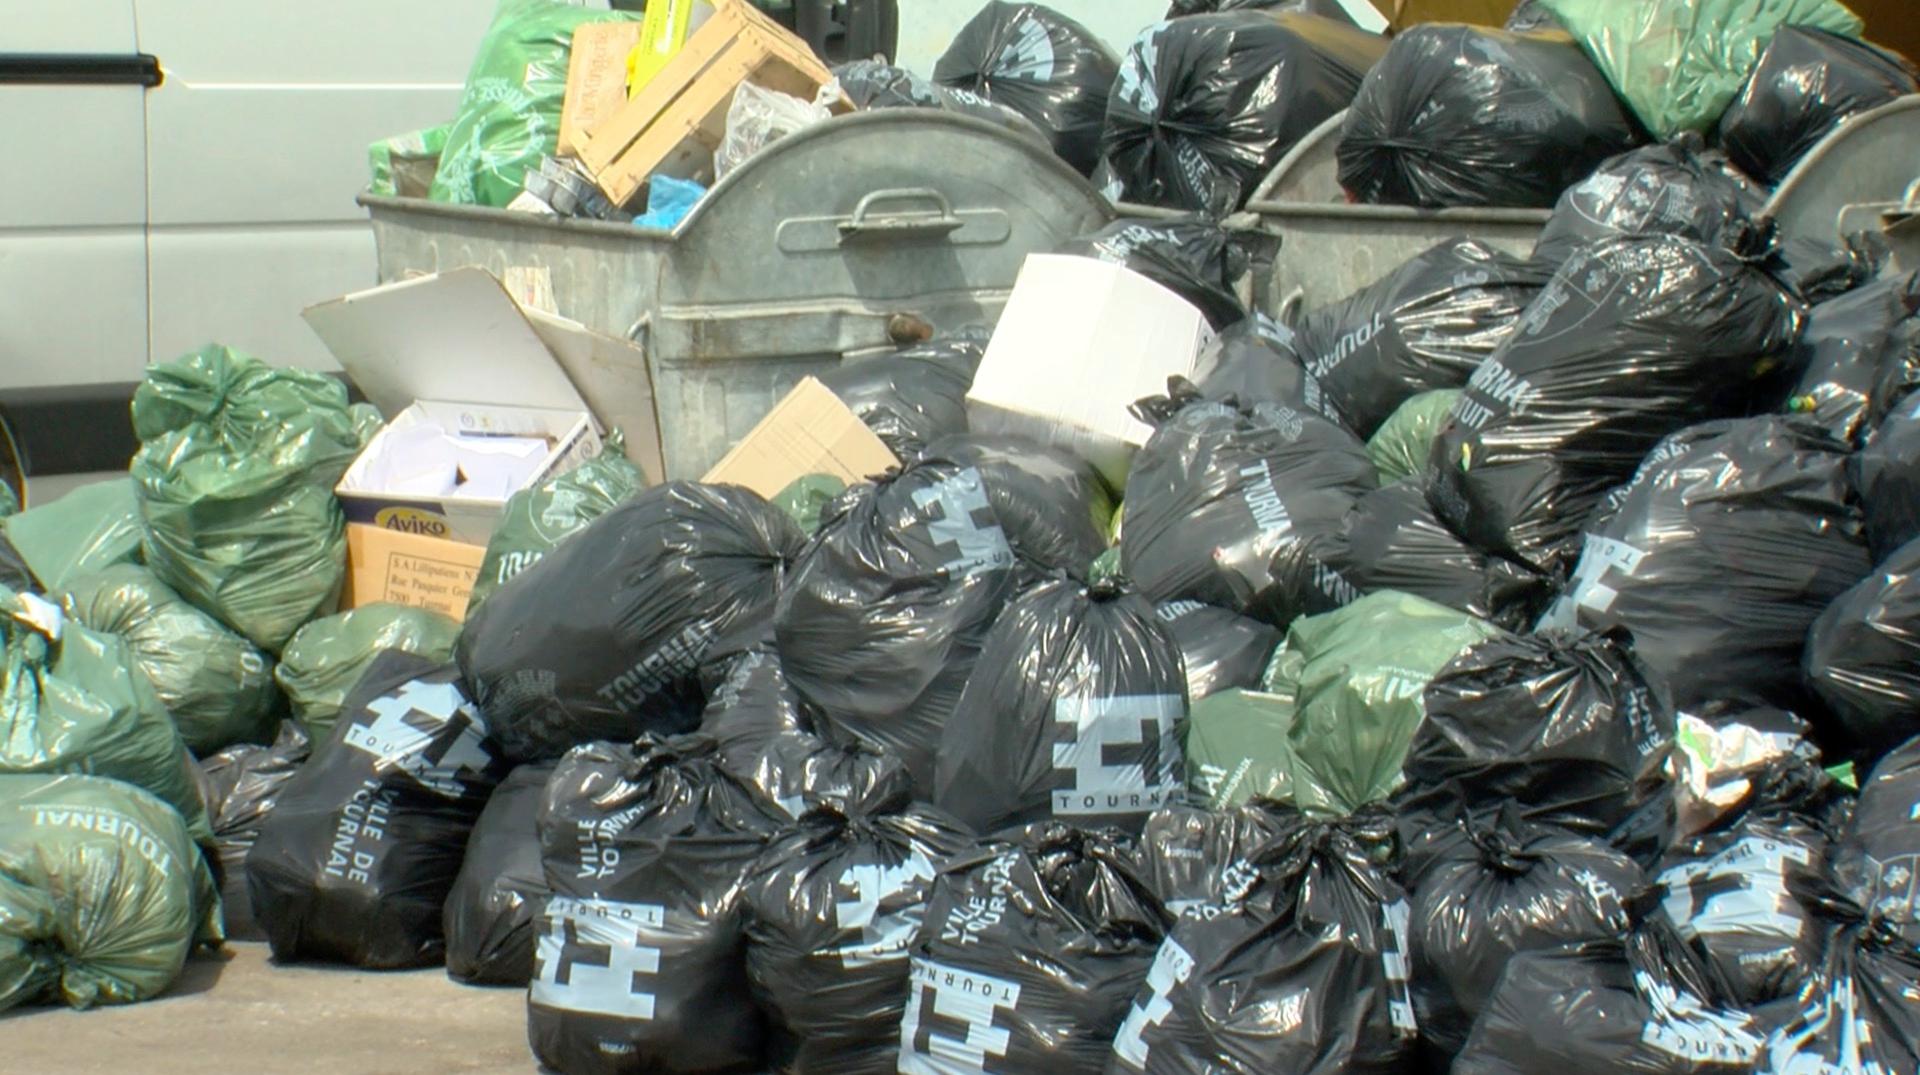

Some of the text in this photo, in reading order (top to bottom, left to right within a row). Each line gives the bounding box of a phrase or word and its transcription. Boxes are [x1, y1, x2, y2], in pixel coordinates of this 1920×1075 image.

[386, 513, 445, 539] Aviko
[390, 573, 408, 588] Rue
[34, 811, 170, 878] TOURNAI
[576, 817, 596, 879] VILLE
[352, 854, 376, 885] DE
[942, 895, 984, 940] VILLE
